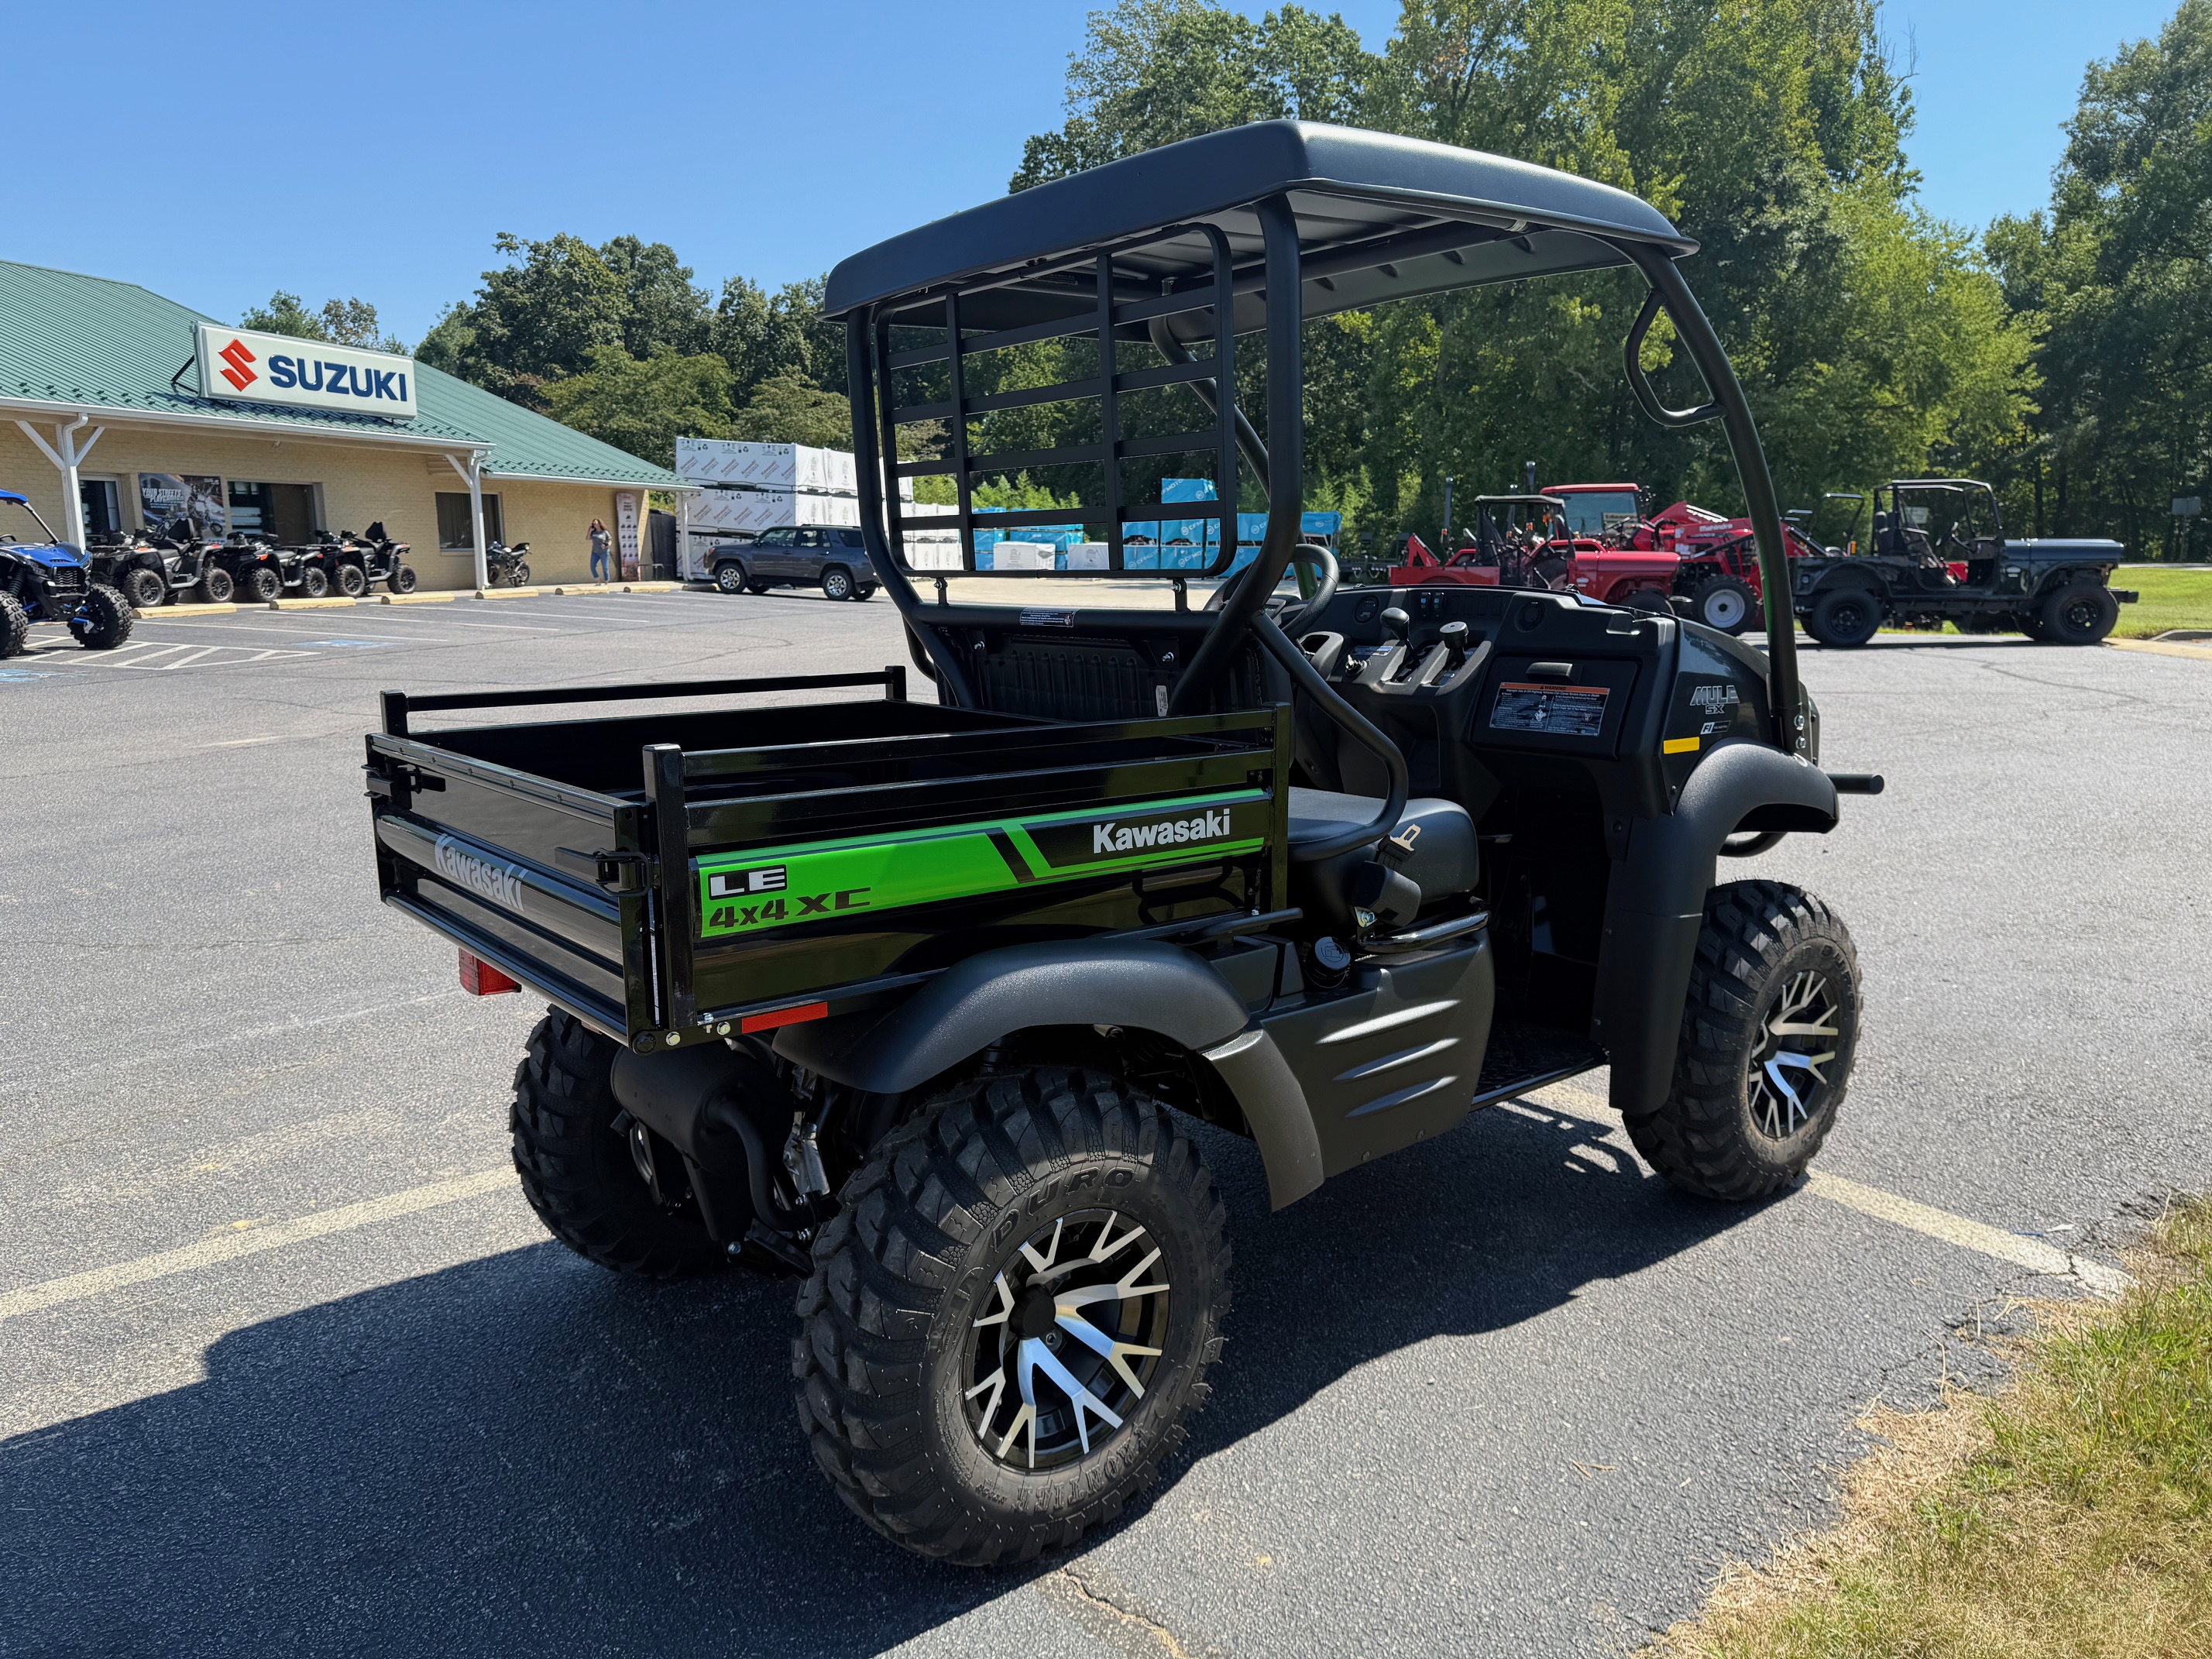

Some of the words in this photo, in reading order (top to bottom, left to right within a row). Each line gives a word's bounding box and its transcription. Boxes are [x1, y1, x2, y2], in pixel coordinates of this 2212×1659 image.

[269, 355, 407, 402] SUZUKI
[1689, 685, 1740, 706] MULE
[1705, 705, 1725, 714] SX
[1702, 723, 1712, 733] FI
[1093, 808, 1231, 854] Kawasaki
[434, 833, 528, 912] Kawasaki
[710, 868, 785, 897] LE
[709, 898, 789, 929] 4x4
[795, 887, 871, 916] XC
[991, 1166, 1135, 1252] DURO
